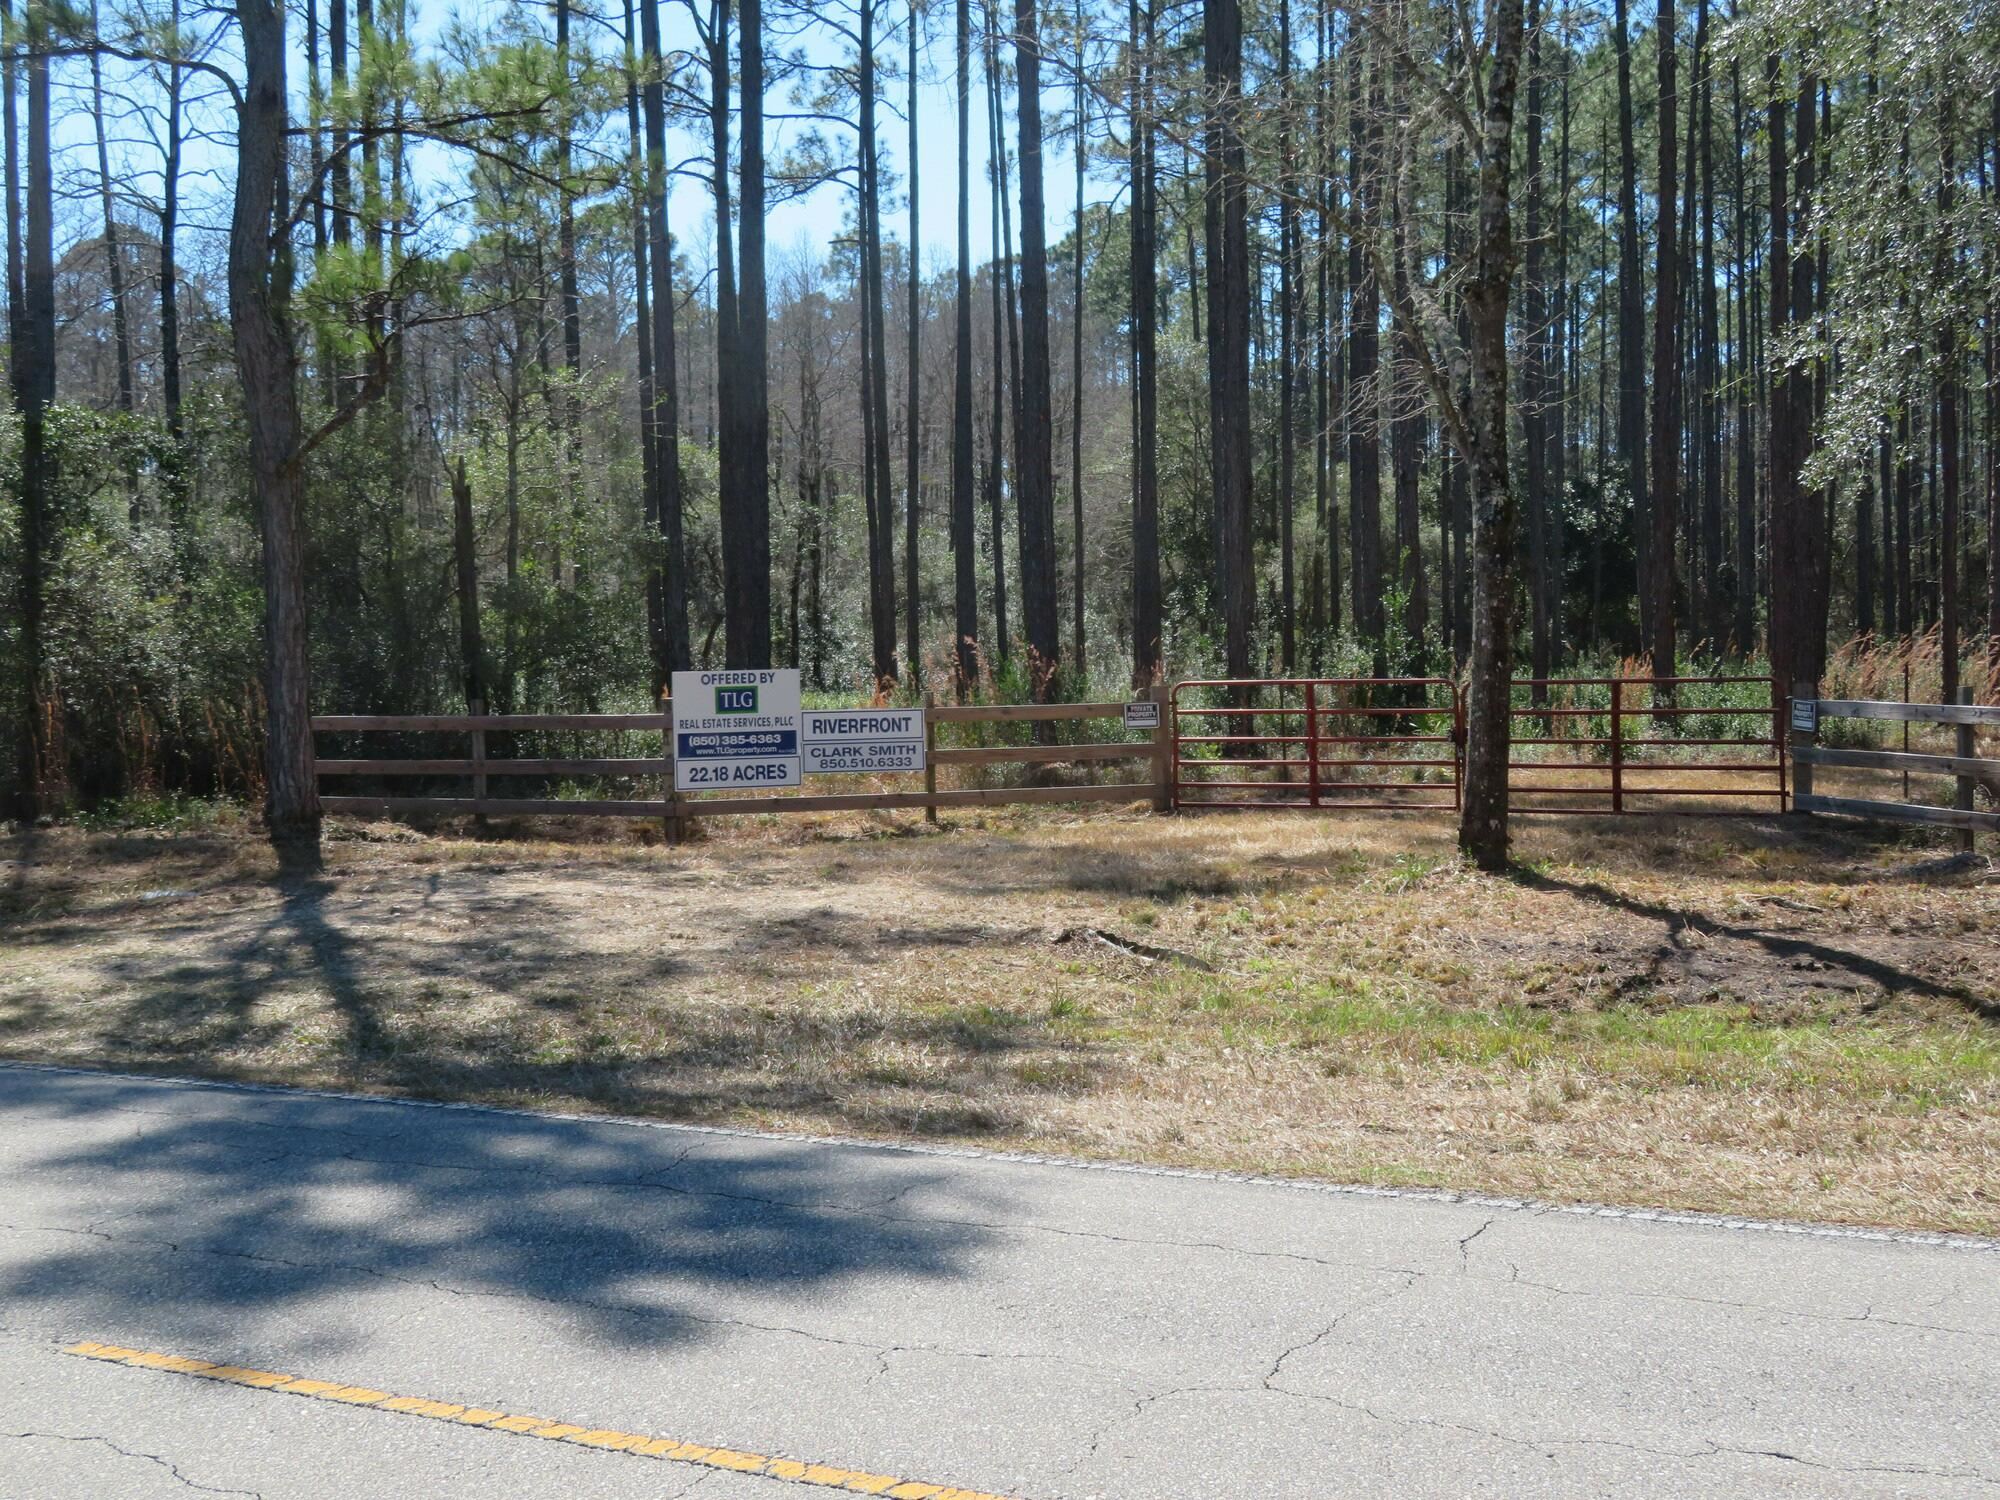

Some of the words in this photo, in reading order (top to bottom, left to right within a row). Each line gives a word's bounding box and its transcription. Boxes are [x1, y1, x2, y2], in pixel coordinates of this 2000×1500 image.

[701, 672, 757, 685] OFFERED
[760, 672, 775, 683] BY
[721, 691, 753, 708] TLG
[680, 719, 700, 729] REAL
[702, 718, 732, 728] ESTATE
[733, 717, 773, 728] SERVICES,
[775, 716, 793, 726] PLLC
[812, 717, 912, 734] RIVERFRONT
[688, 735, 720, 747] (850)
[696, 746, 777, 755] www.TLGproperty.com
[810, 746, 863, 758] CLARK
[868, 745, 916, 756] SMITH
[820, 757, 912, 769] 850.510.6333
[689, 766, 729, 782] 22.18
[733, 764, 787, 781] ACRES
